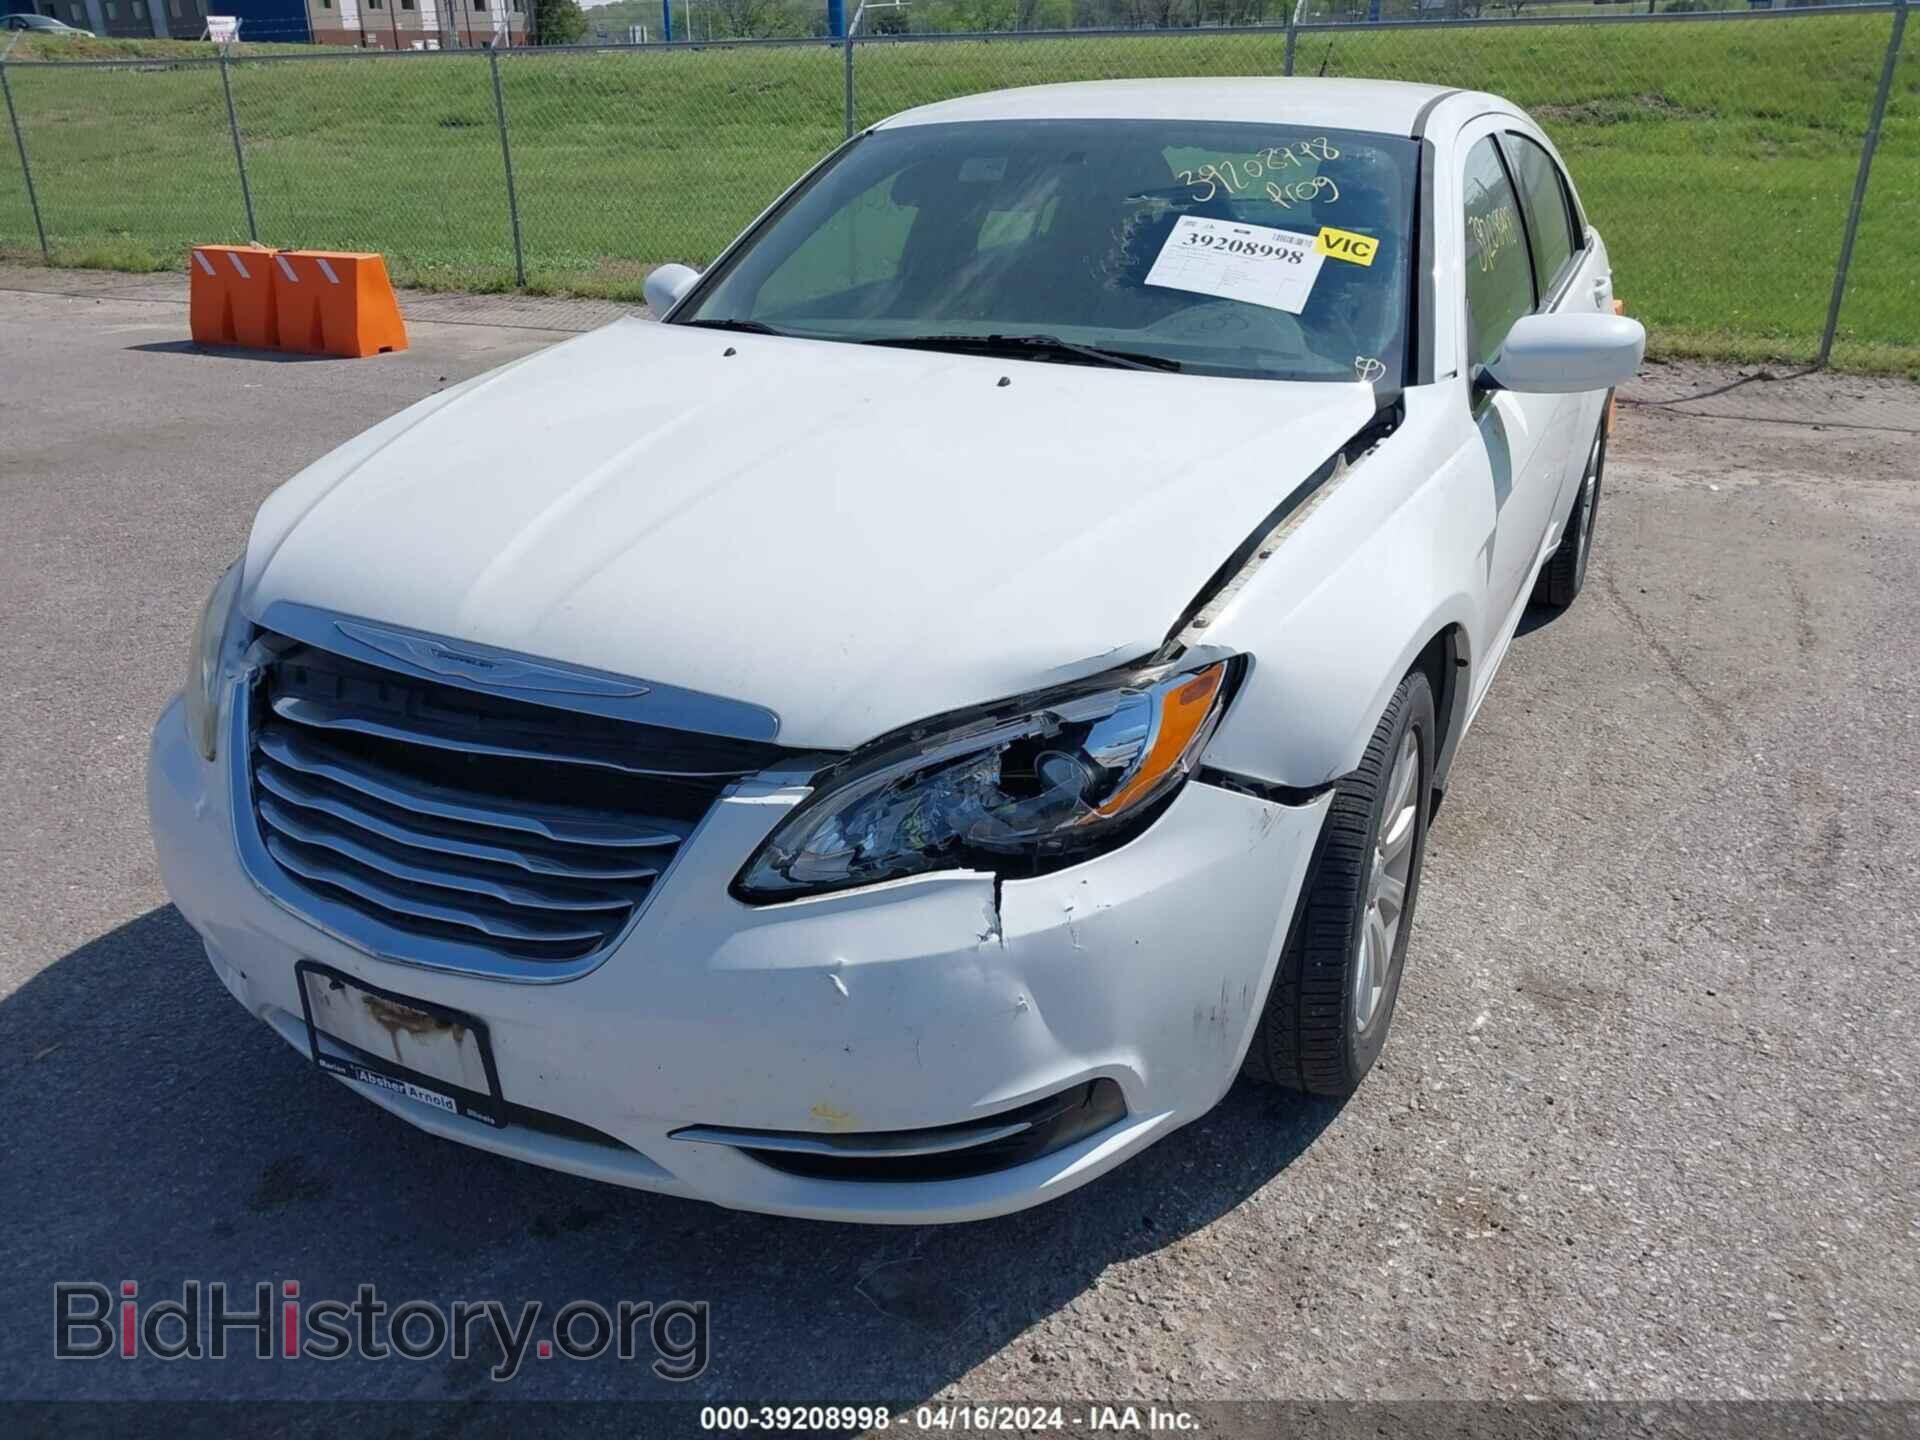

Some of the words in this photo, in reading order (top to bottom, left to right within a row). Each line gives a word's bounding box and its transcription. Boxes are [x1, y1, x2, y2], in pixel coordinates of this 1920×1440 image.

[1182, 231, 1305, 265] 39208998
[1323, 233, 1371, 258] VIC
[359, 1070, 405, 1095] Absher
[408, 1085, 455, 1111] Arnold
